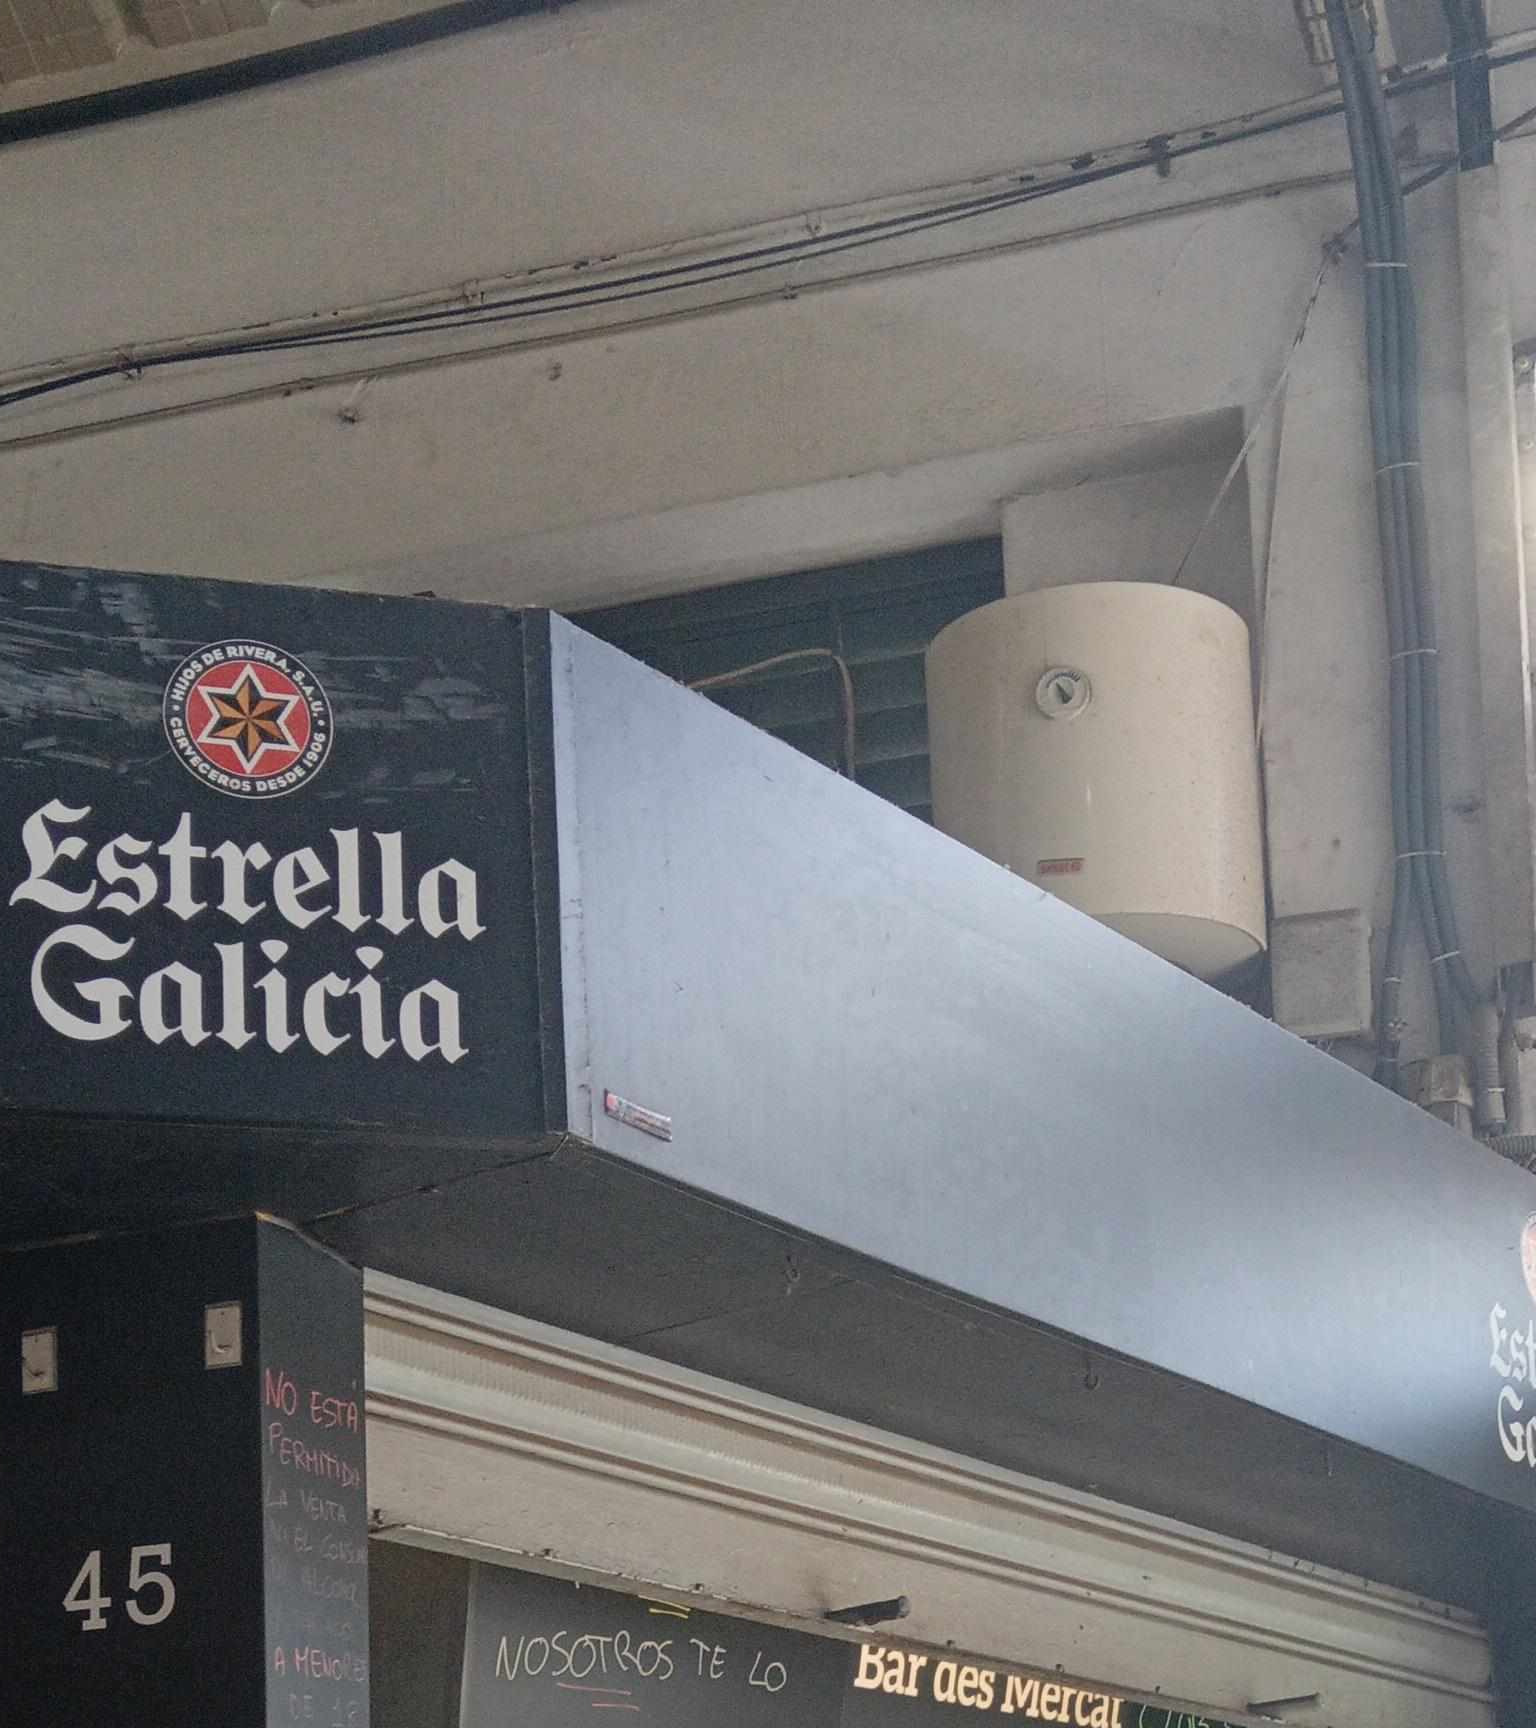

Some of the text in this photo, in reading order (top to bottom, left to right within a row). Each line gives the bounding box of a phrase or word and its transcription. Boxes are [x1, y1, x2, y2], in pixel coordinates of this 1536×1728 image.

[171, 659, 204, 702] HIJOS
[201, 648, 224, 666] DE
[170, 717, 327, 792] CERVECEROS DESDE 1906
[9, 797, 487, 942] Estrella
[31, 923, 470, 1065] Galicia
[264, 1366, 298, 1417] NO
[299, 1487, 348, 1524] VENTA
[62, 1542, 176, 1632] 45
[273, 1645, 287, 1679] A
[494, 1629, 790, 1693] NOSOTROS TE LO
[852, 1642, 928, 1698] Bar
[932, 1660, 996, 1710] des
